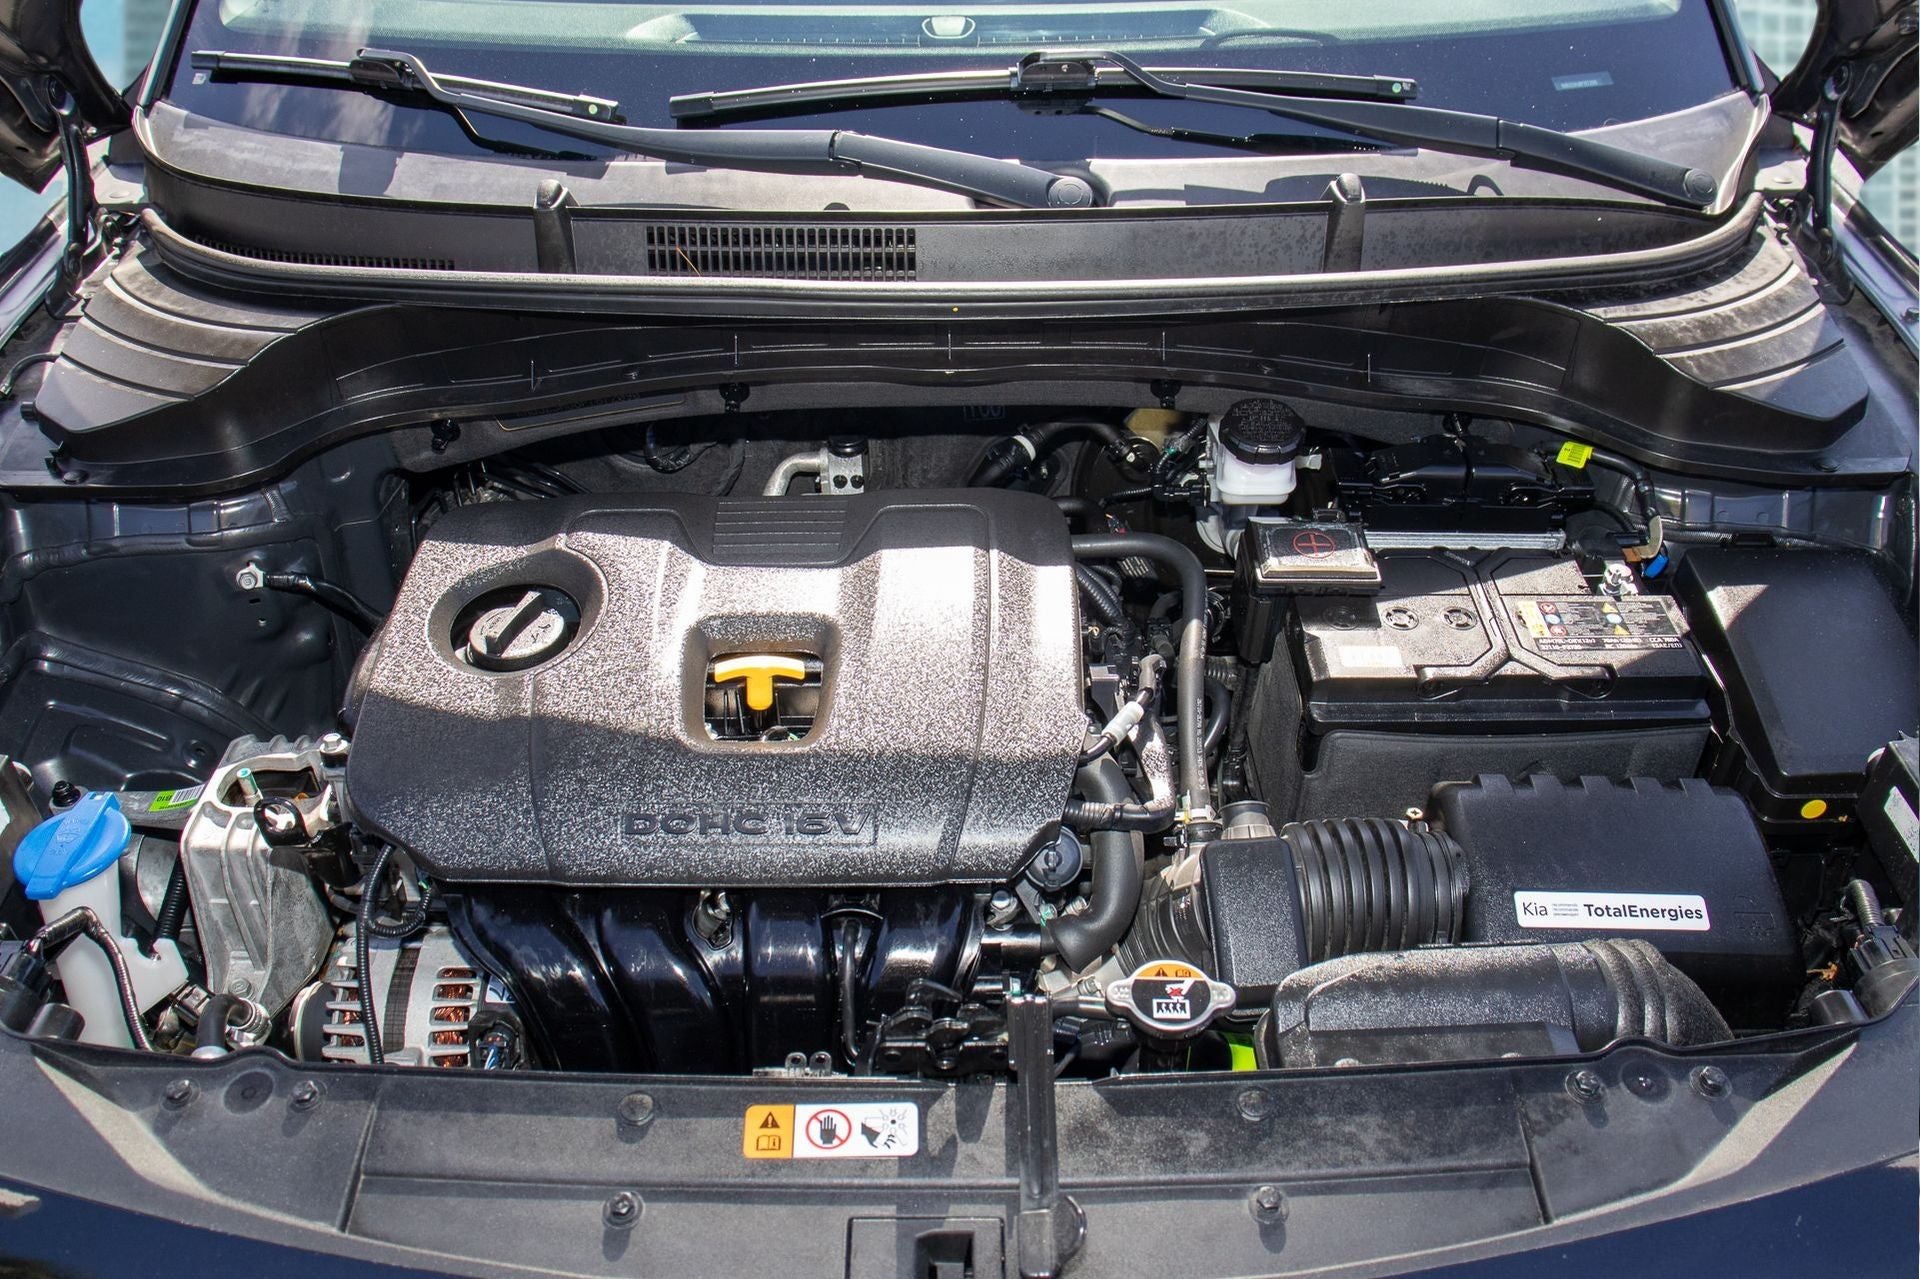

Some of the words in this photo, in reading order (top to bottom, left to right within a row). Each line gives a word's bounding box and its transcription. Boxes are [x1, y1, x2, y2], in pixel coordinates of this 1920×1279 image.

[624, 812, 769, 835] DOHC
[784, 811, 871, 836] 16V
[1522, 902, 1548, 916] Kia
[1583, 903, 1704, 921] TotalEnergies
